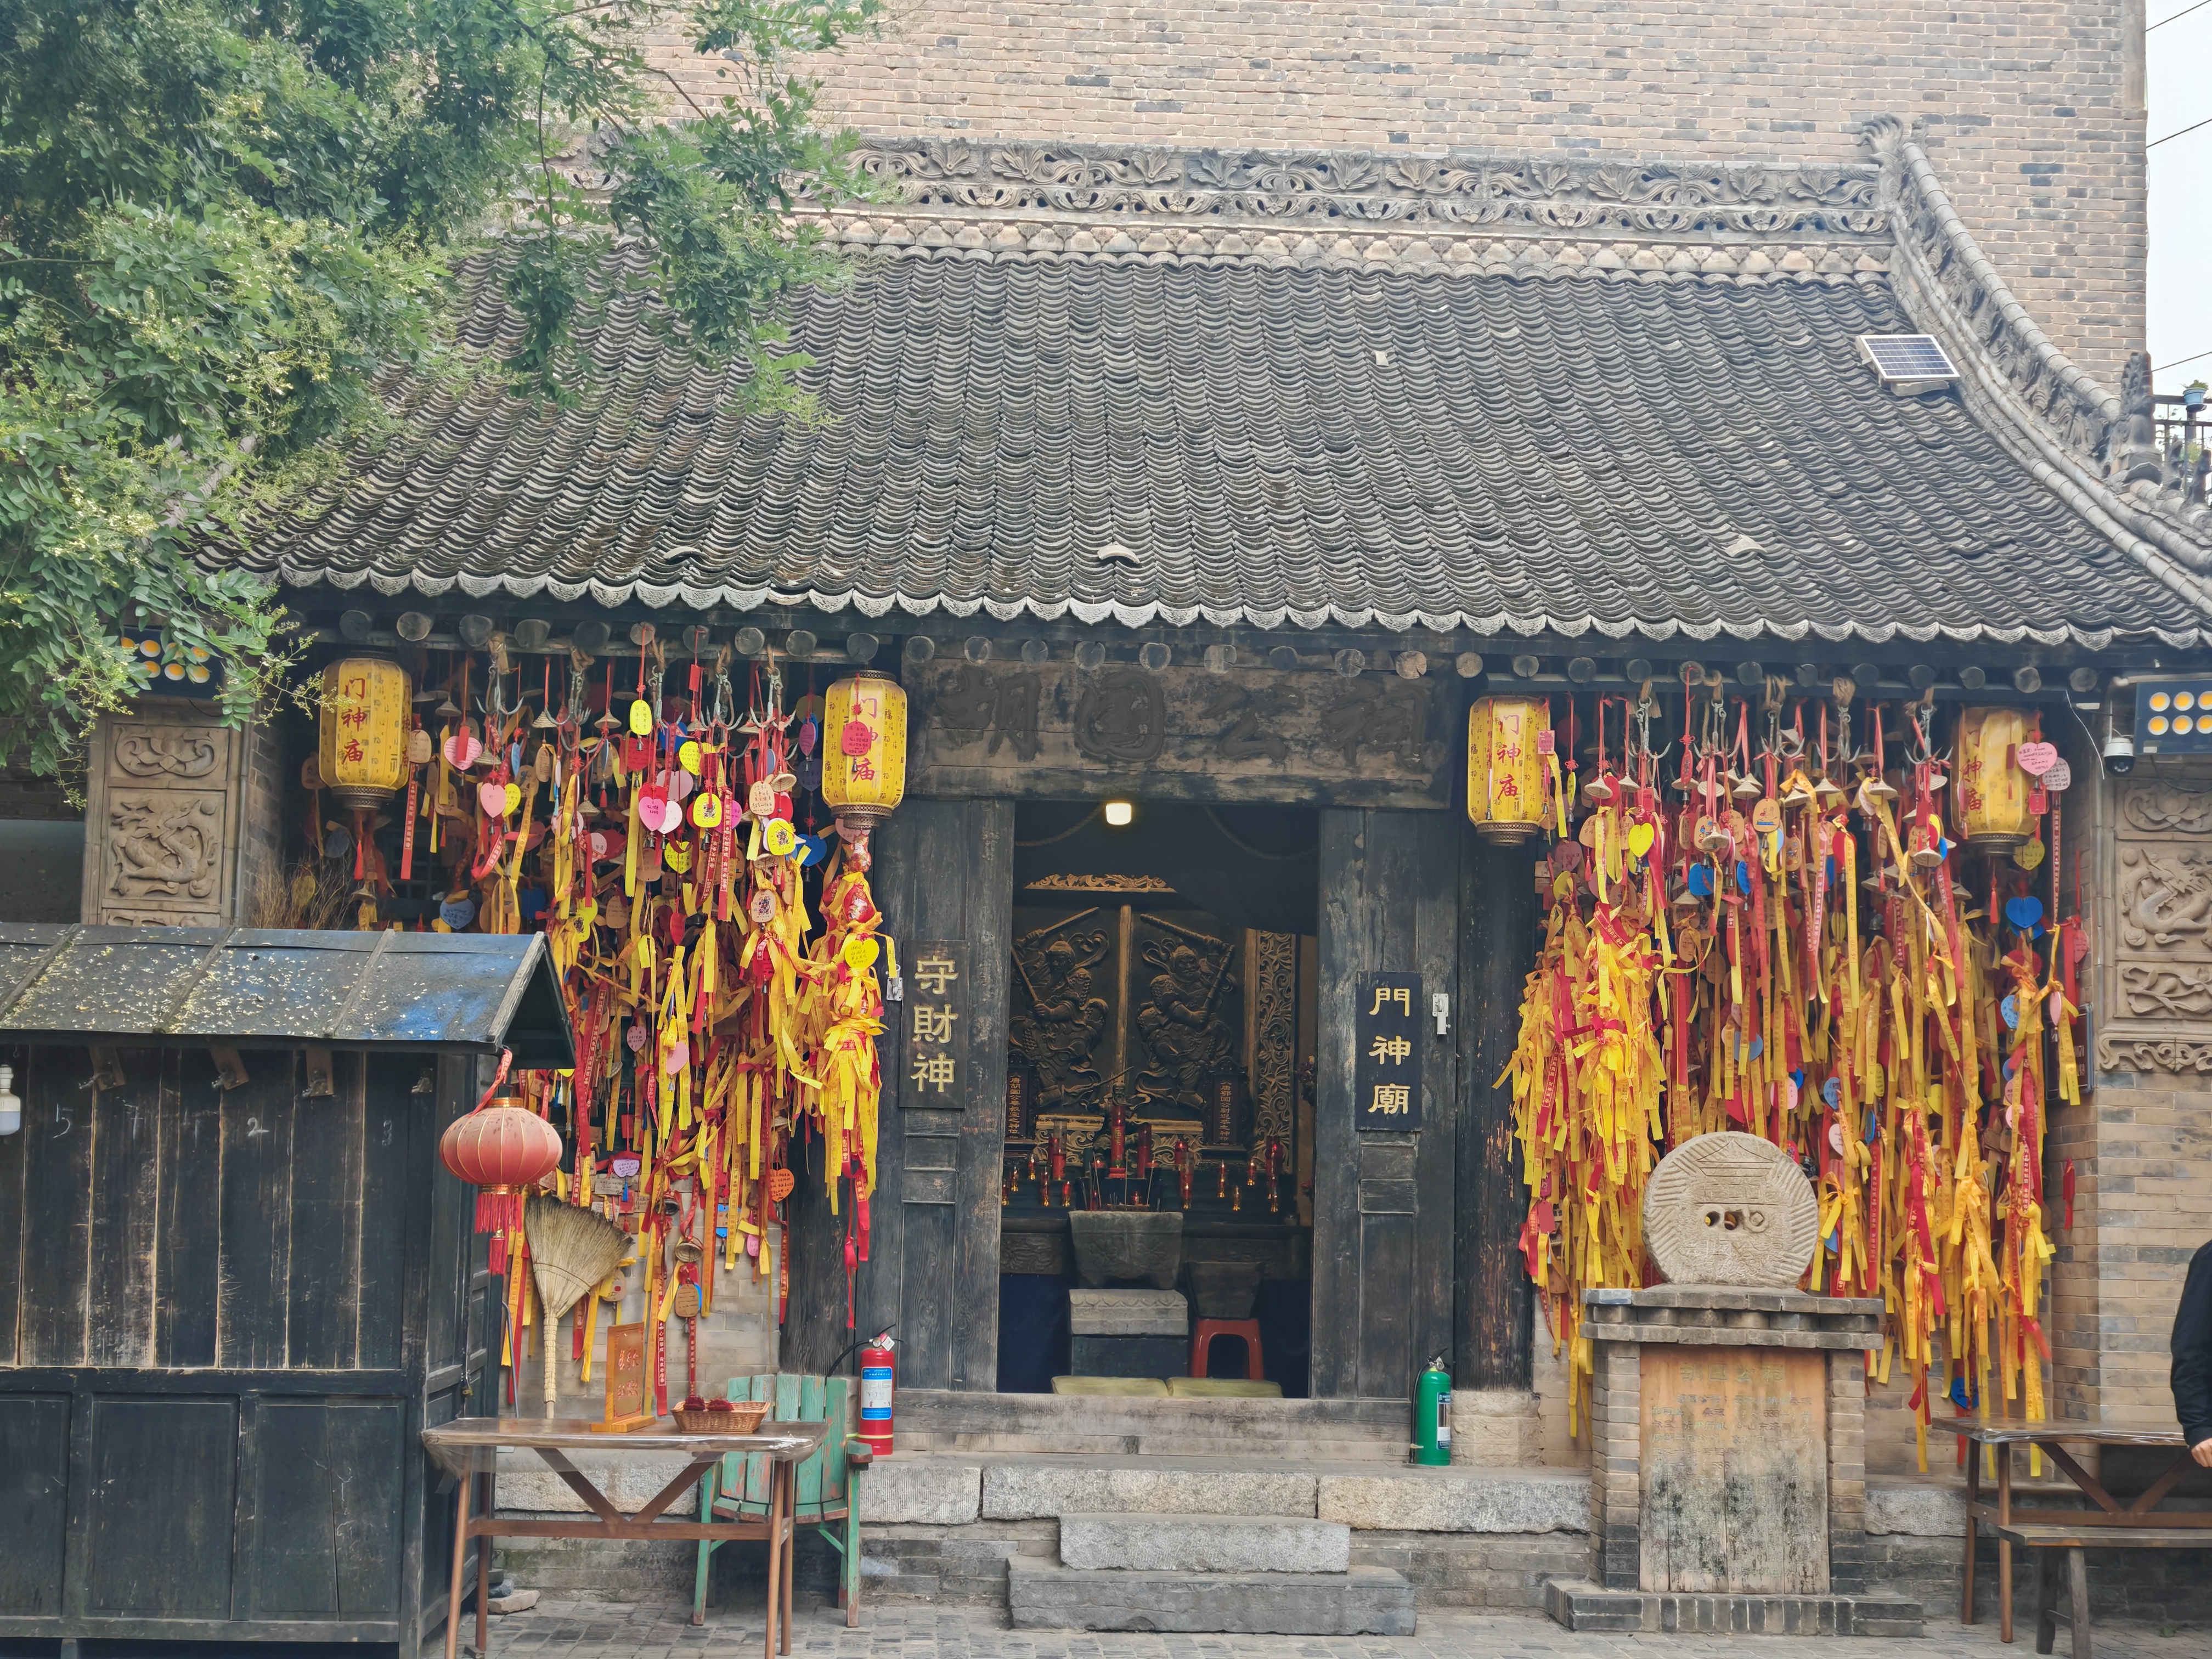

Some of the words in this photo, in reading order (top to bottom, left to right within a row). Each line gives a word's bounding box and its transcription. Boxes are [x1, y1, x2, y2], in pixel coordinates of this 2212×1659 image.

[341, 678, 367, 765] 门神庙
[1497, 714, 1521, 799] 门神庙
[911, 955, 958, 1092] 守財神
[1368, 988, 1411, 1114] 門神廟
[247, 1117, 269, 1136] 2
[382, 1120, 392, 1146] 3
